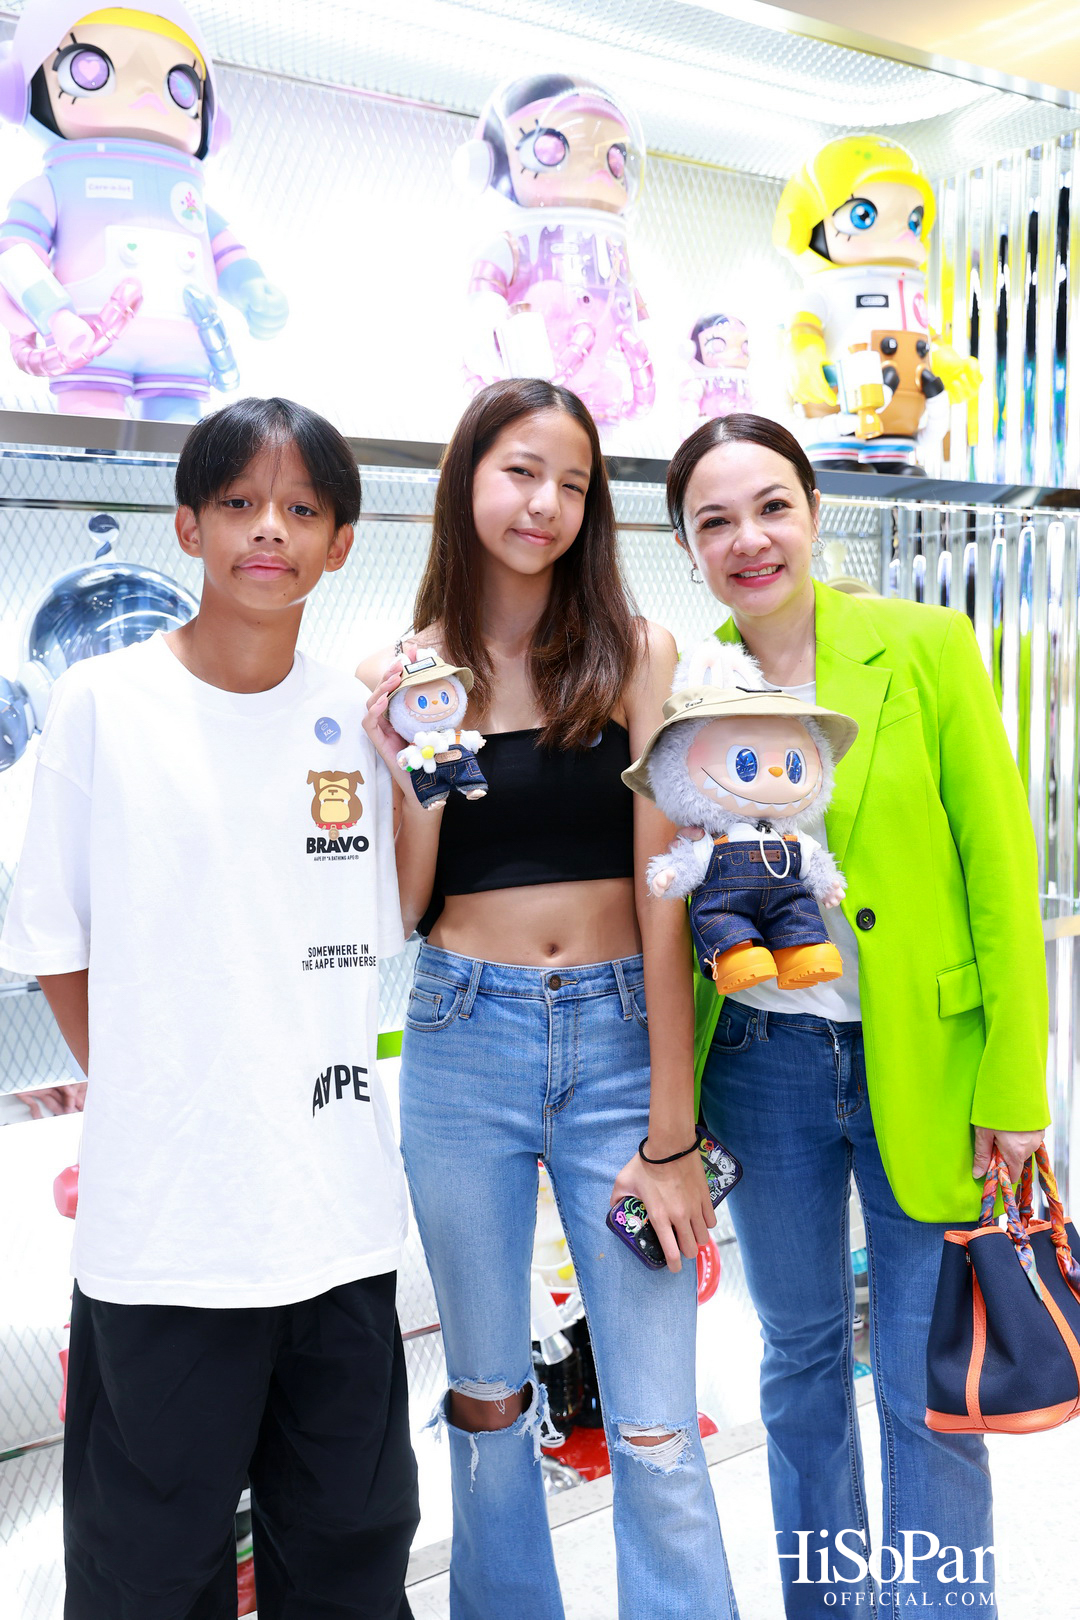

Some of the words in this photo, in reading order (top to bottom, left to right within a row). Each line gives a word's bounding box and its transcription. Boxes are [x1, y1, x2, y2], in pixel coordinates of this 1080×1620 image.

[306, 836, 369, 854] BRAVO
[308, 944, 358, 958] SOMEWHERE
[361, 944, 369, 955] IN
[302, 960, 313, 971] THE
[315, 958, 335, 970] AAPE
[337, 956, 377, 968] UNIVERSE
[312, 1064, 371, 1119] AAPE
